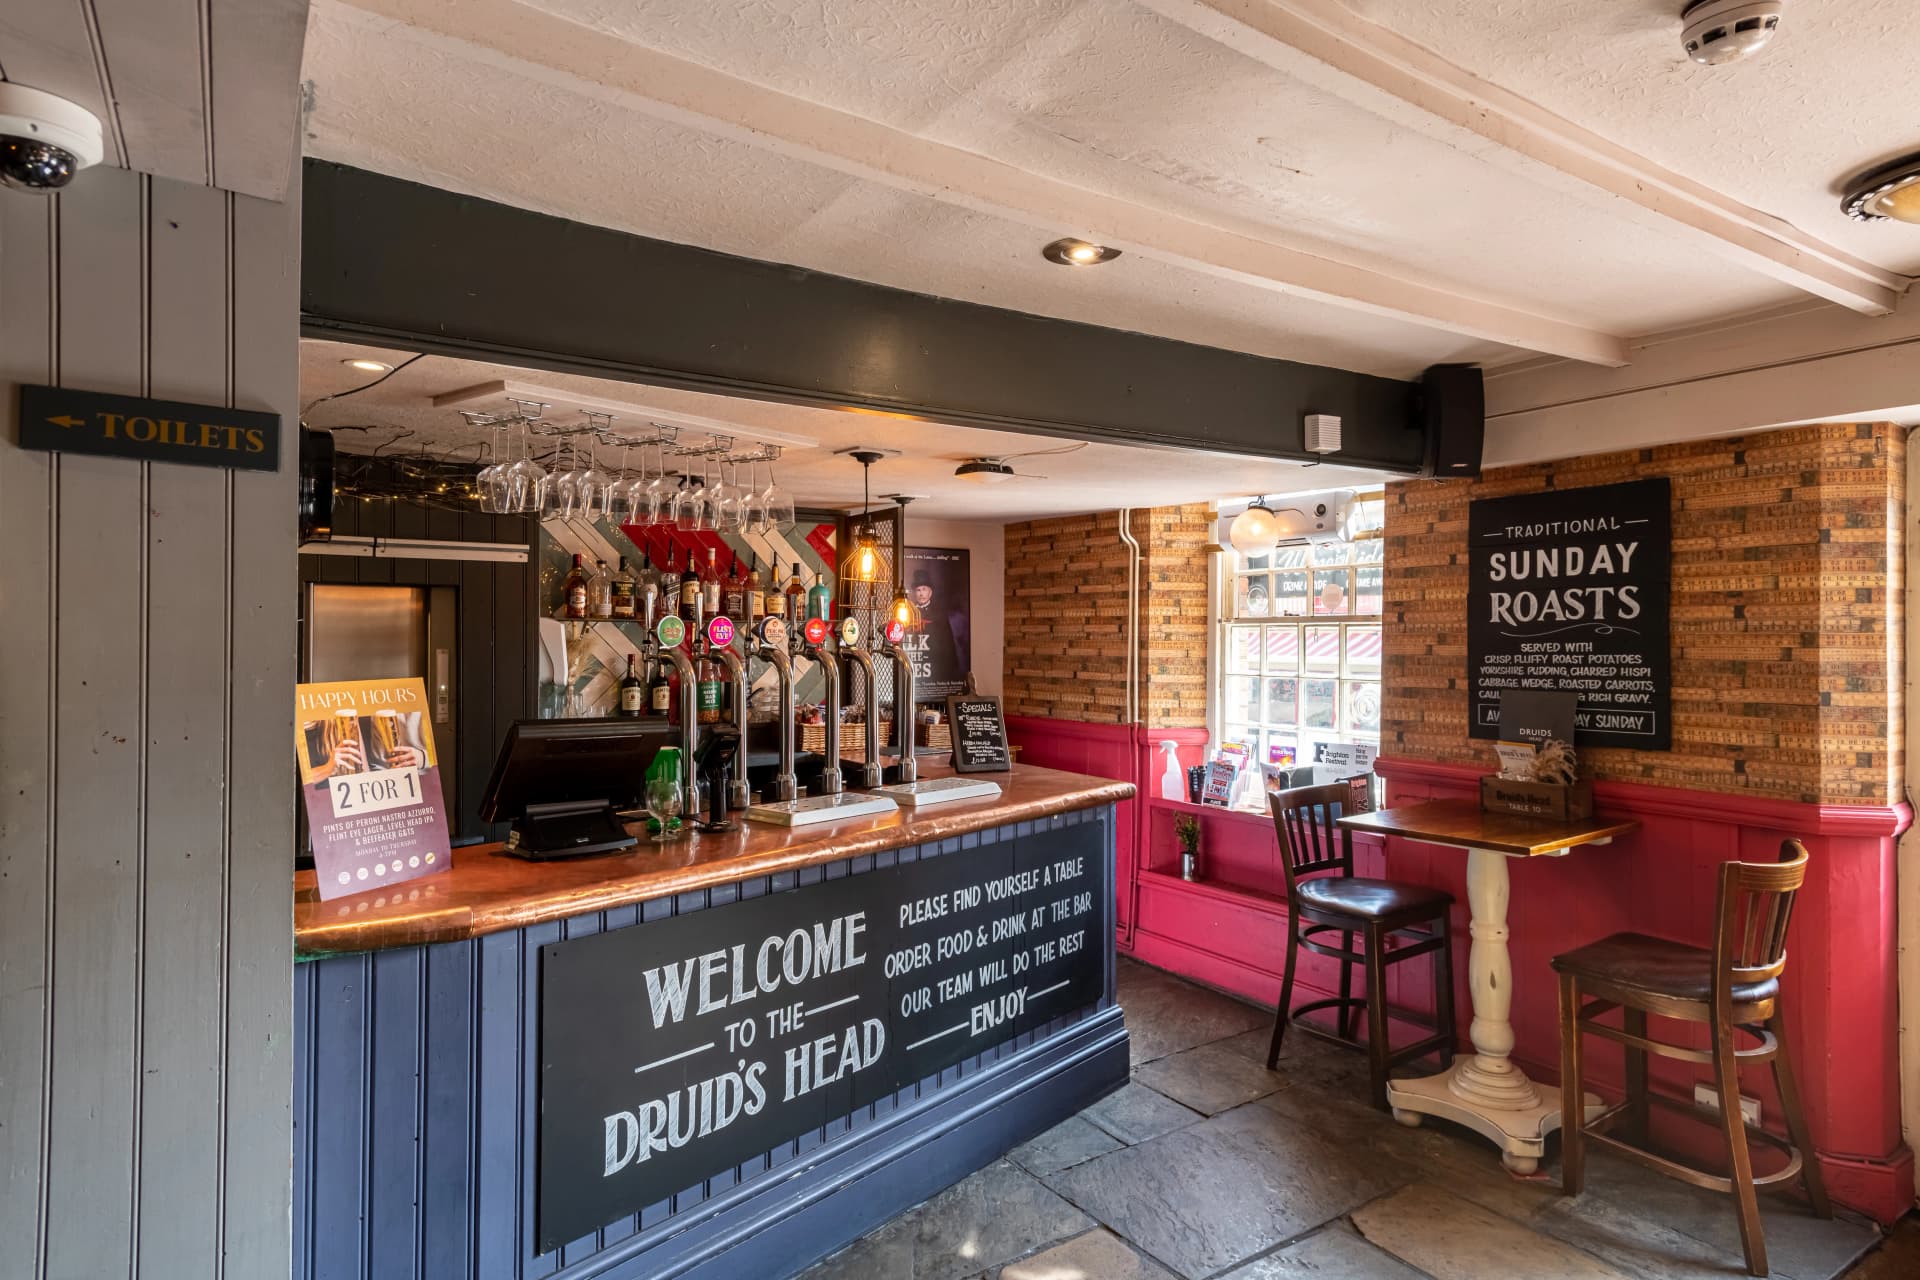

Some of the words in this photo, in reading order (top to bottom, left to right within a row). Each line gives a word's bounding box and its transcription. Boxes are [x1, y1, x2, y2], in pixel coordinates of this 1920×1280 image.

[96, 412, 265, 453] TOILETS
[1505, 516, 1621, 539] TRADITIONAL
[1489, 542, 1639, 582] SUNDAY
[1489, 586, 1641, 627] ROASTS
[1521, 643, 1561, 653] SERVED
[1565, 642, 1593, 652] WITH
[1514, 654, 1548, 664] FLUFFY
[1552, 655, 1585, 664] ROAST
[1588, 654, 1643, 664] POTATOES
[1480, 665, 1524, 676] YORKSHIRE
[1570, 667, 1617, 677] CHARRED
[1620, 667, 1652, 678] HISPI
[1478, 678, 1519, 688] CABBAGE
[1558, 680, 1601, 689] ROASTED
[1605, 680, 1656, 693] CARROTS,
[301, 691, 356, 710] HAPPY
[361, 688, 417, 705] HOURS
[962, 702, 993, 713] SPECIALS
[1588, 693, 1612, 702] RICH
[1520, 728, 1552, 737] DRUIDS
[1595, 714, 1644, 730] SUNDAY
[1325, 751, 1350, 759] Brighton
[337, 782, 353, 809] 2
[359, 779, 399, 803] FOR
[404, 772, 415, 798] 1
[1508, 803, 1529, 812] TABLE
[323, 823, 344, 833] PINTS
[356, 818, 380, 828] PERONI
[382, 811, 406, 822] NASTRO
[329, 831, 348, 842] FLINT
[350, 828, 361, 838] EYE
[387, 820, 406, 830] LEVEL
[407, 817, 423, 826] HEAD
[363, 832, 397, 845] BEEFEATER
[900, 894, 948, 928] PLEASE
[954, 885, 981, 913] FIND
[985, 869, 1040, 903] YOURSELF
[1044, 865, 1052, 886] A
[1054, 857, 1084, 883] TABLE
[884, 943, 932, 979] ORDER
[937, 930, 973, 961] FOOD
[976, 925, 988, 947] &
[992, 912, 1027, 943] DRINK
[1031, 906, 1046, 931] AT
[1051, 898, 1070, 923] THE
[1073, 891, 1092, 916] BAR
[642, 910, 867, 1029] WELCOME
[901, 987, 932, 1018] OUR
[937, 970, 973, 1003] TEAM
[979, 959, 1008, 987] WILL
[1013, 951, 1029, 975] DO
[1034, 941, 1056, 966] THE
[1059, 930, 1085, 957] REST
[970, 986, 1029, 1037] ENJOY
[724, 1018, 757, 1052] TO
[766, 1002, 805, 1038] THE
[603, 1058, 767, 1177] DRUID'S
[782, 1018, 886, 1102] HEAD
